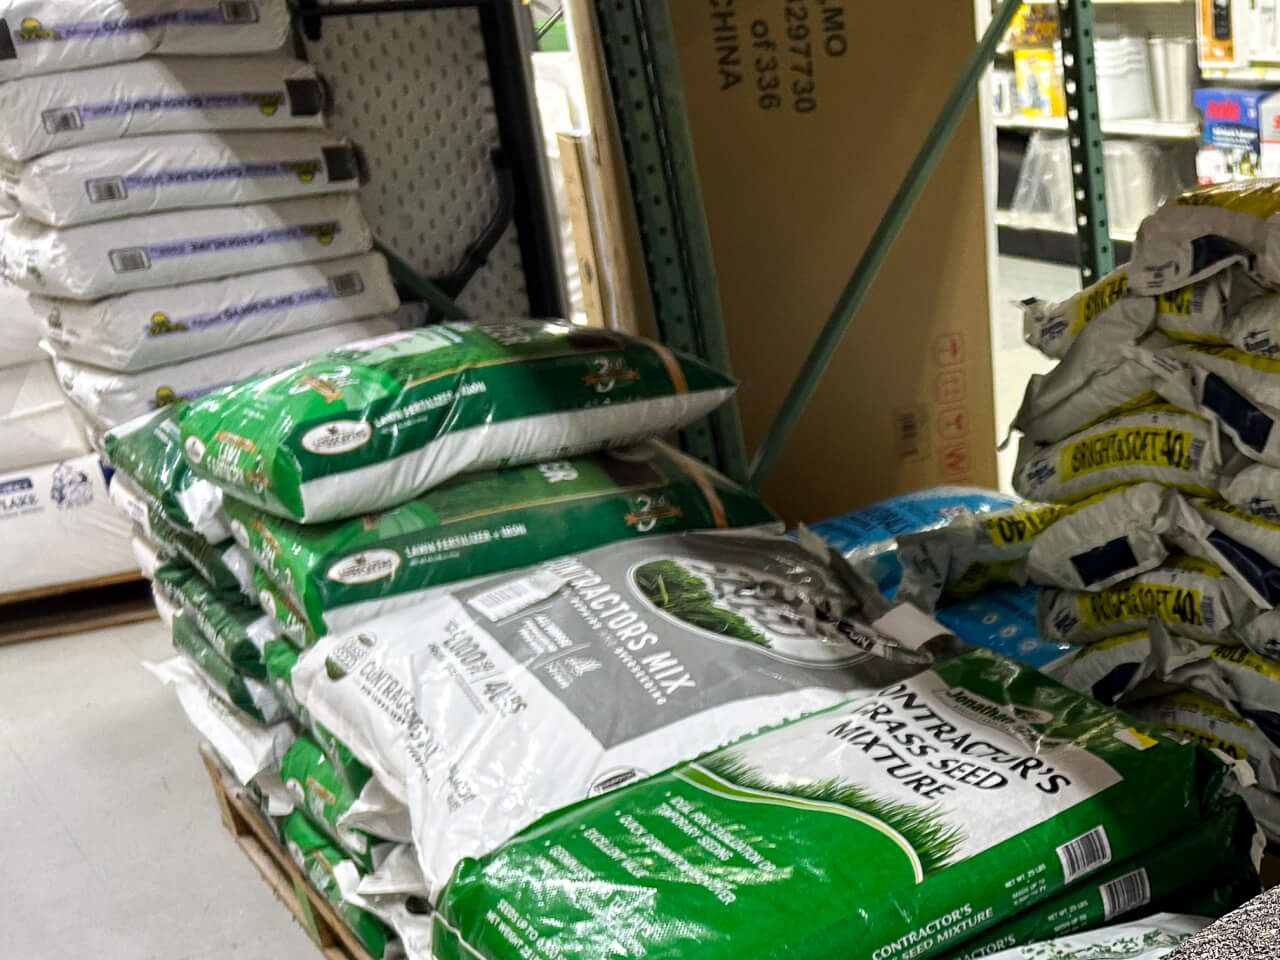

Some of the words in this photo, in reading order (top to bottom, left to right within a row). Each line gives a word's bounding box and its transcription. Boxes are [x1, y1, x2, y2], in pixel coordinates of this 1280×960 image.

[543, 556, 659, 652] NTRACTORS
[641, 650, 697, 695] MIX
[826, 718, 957, 801] MIXTURE
[881, 682, 1073, 795] ONTRACTOR'S
[929, 751, 1010, 793] SEED
[936, 906, 994, 945] MIXTURE
